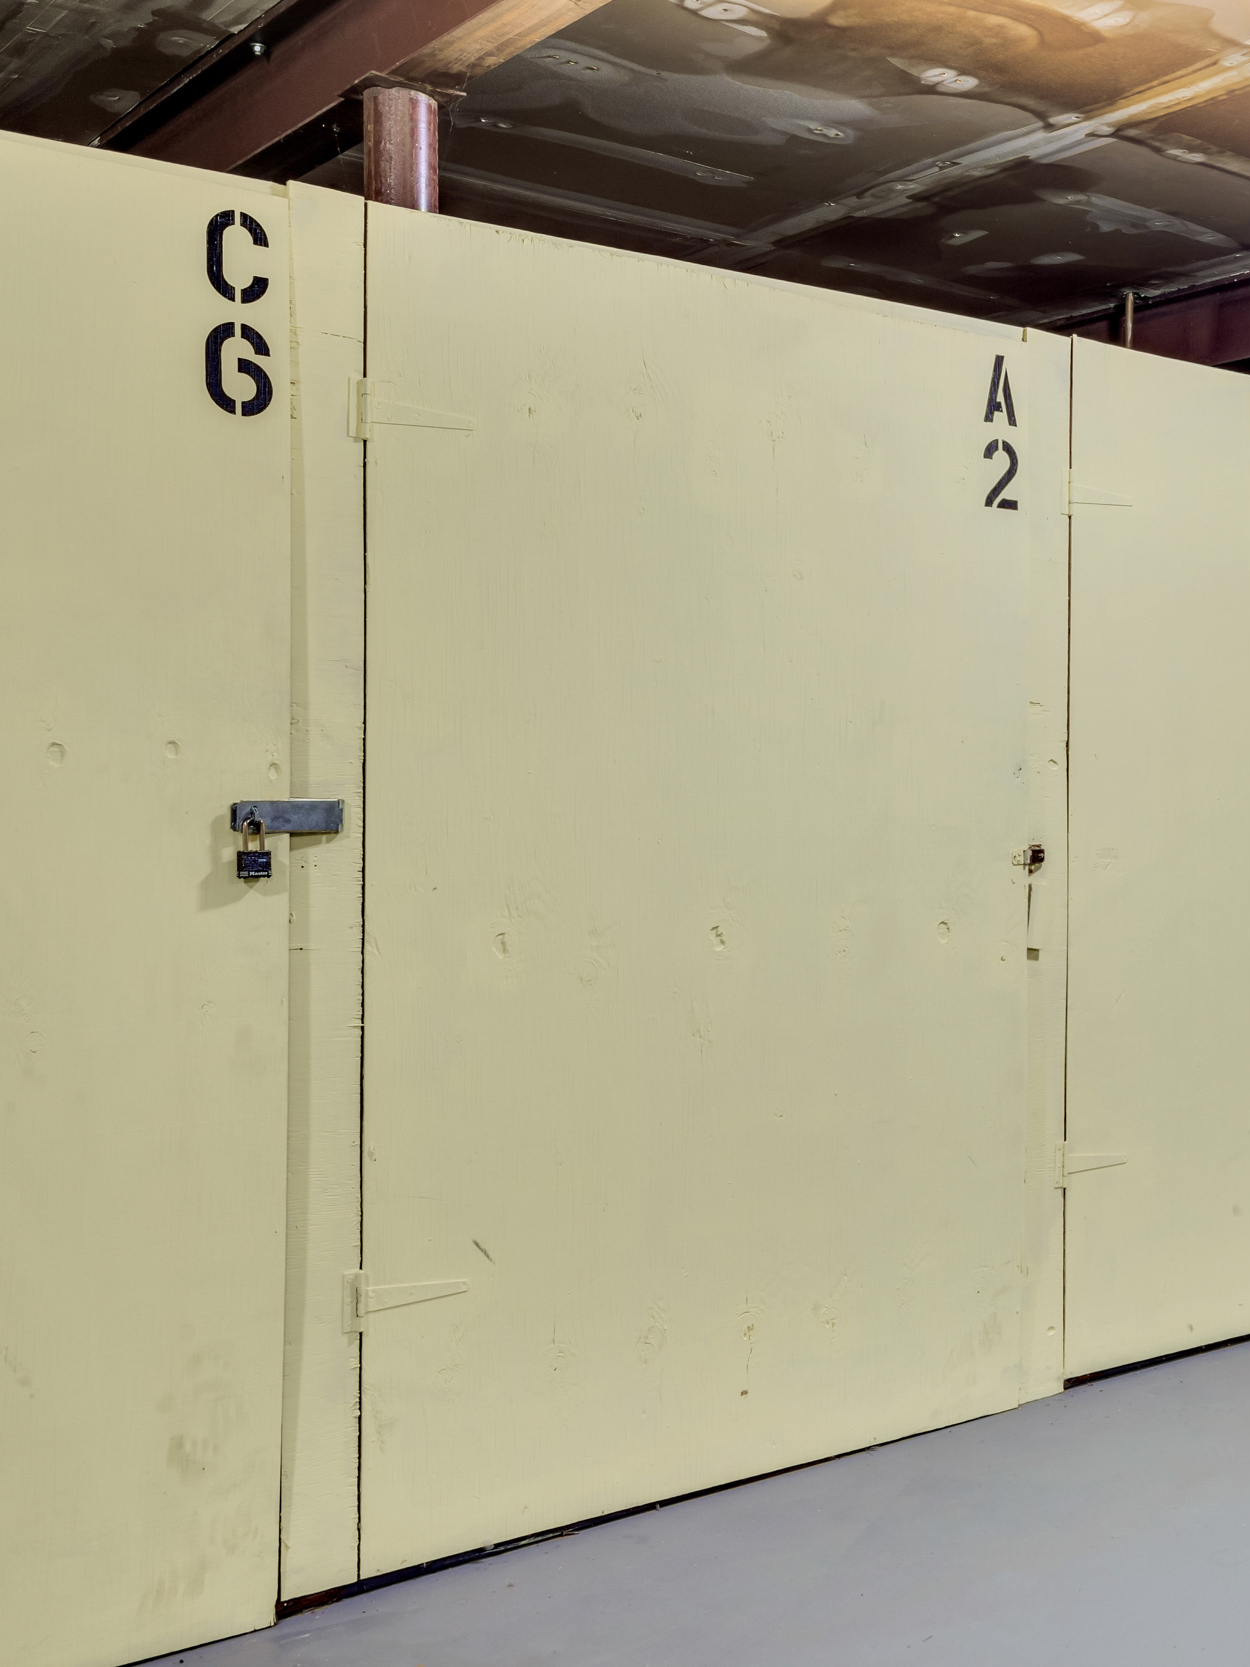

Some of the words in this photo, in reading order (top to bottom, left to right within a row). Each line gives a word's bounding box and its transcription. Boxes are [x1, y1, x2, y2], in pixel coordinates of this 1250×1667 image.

[206, 209, 269, 304] C
[205, 321, 273, 417] 6
[983, 354, 1018, 427] A
[983, 438, 1019, 511] 2
